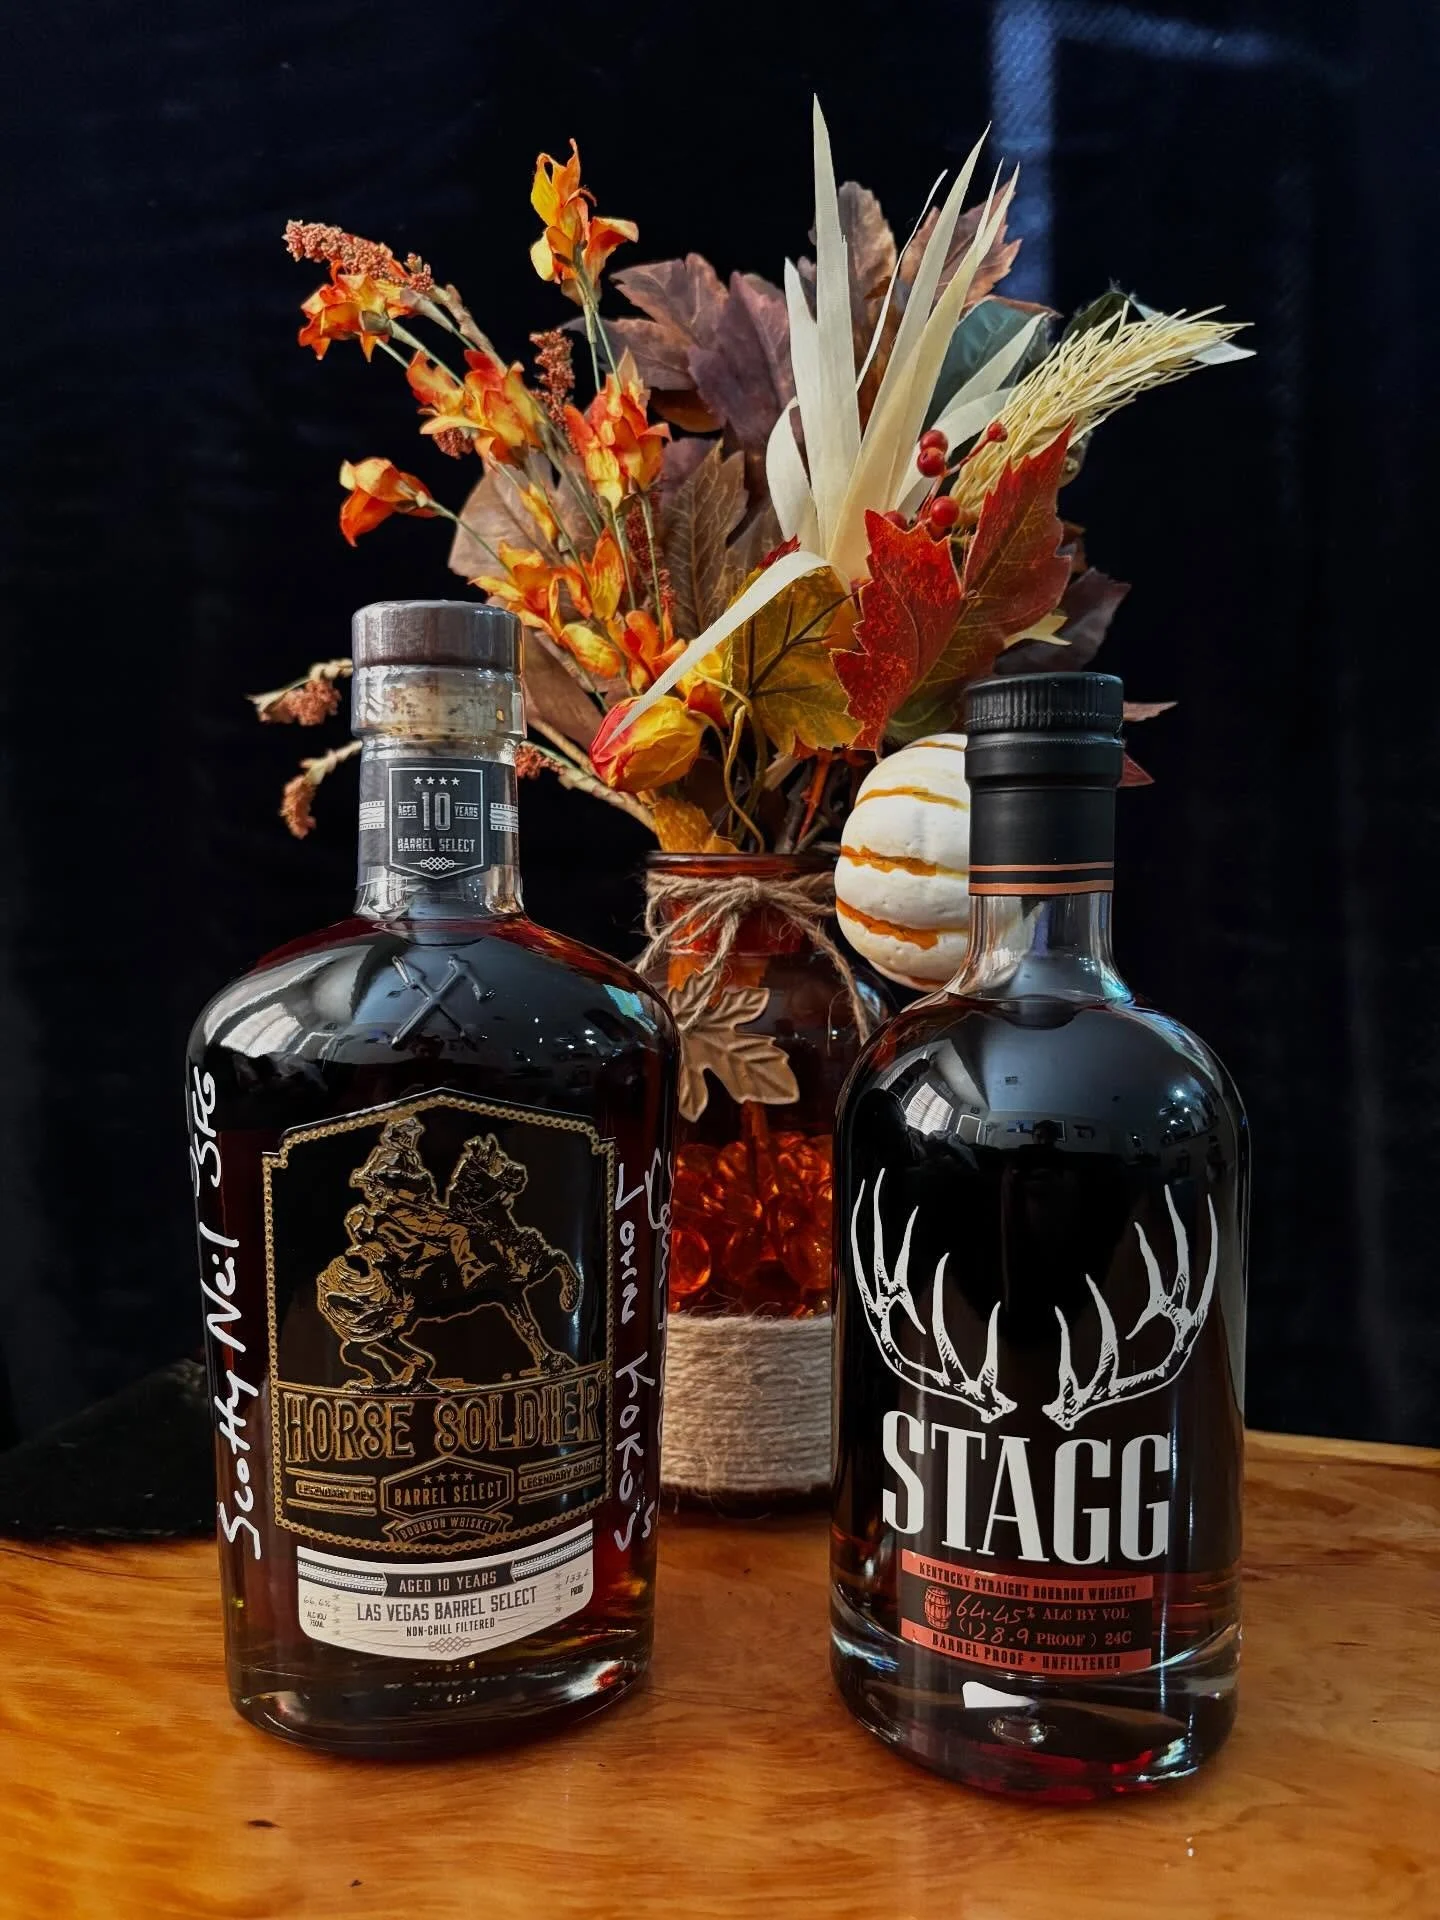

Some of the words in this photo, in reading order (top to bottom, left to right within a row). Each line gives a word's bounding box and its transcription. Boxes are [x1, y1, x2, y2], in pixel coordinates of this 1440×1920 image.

[398, 805, 417, 816] AGED
[422, 792, 451, 831] 10
[454, 805, 479, 818] YEARS
[397, 837, 435, 852] BARREL
[438, 838, 476, 853] SELECT
[199, 1221, 246, 1352] Neil
[283, 1391, 416, 1464] HORSE
[433, 1374, 602, 1453] SOLDIER
[214, 1369, 262, 1560] Scotty
[299, 1484, 350, 1499] LEGENDARY
[521, 1467, 571, 1490] LEGENDARY
[882, 1410, 1171, 1566] STAGG
[394, 1487, 447, 1506] BARREL
[453, 1479, 503, 1503] SELECT
[400, 1517, 446, 1540] BOURBON
[450, 1516, 496, 1533] WHISKEY
[399, 1579, 432, 1593] AGED
[438, 1577, 450, 1591] 10
[456, 1570, 497, 1589] YEARS
[919, 1561, 971, 1588] KENTUCKY
[974, 1576, 1029, 1598] STRAIGHT
[1033, 1585, 1084, 1601] BOURBON
[1088, 1585, 1137, 1601] WHISKEY
[357, 1602, 381, 1621] LAS
[387, 1601, 430, 1621] VEGAS
[434, 1597, 486, 1620] BARREL
[490, 1585, 537, 1612] SELECT
[1042, 1607, 1072, 1621] ALC
[1077, 1608, 1097, 1621] BY
[1103, 1607, 1130, 1620] VOL
[406, 1623, 453, 1637] NON-CHILL
[456, 1617, 495, 1633] FILTERED
[1036, 1632, 1086, 1647] PROOF
[931, 1632, 979, 1658] BARREL
[984, 1646, 1025, 1666] PROOF
[1042, 1655, 1121, 1671] UNFILTERED
